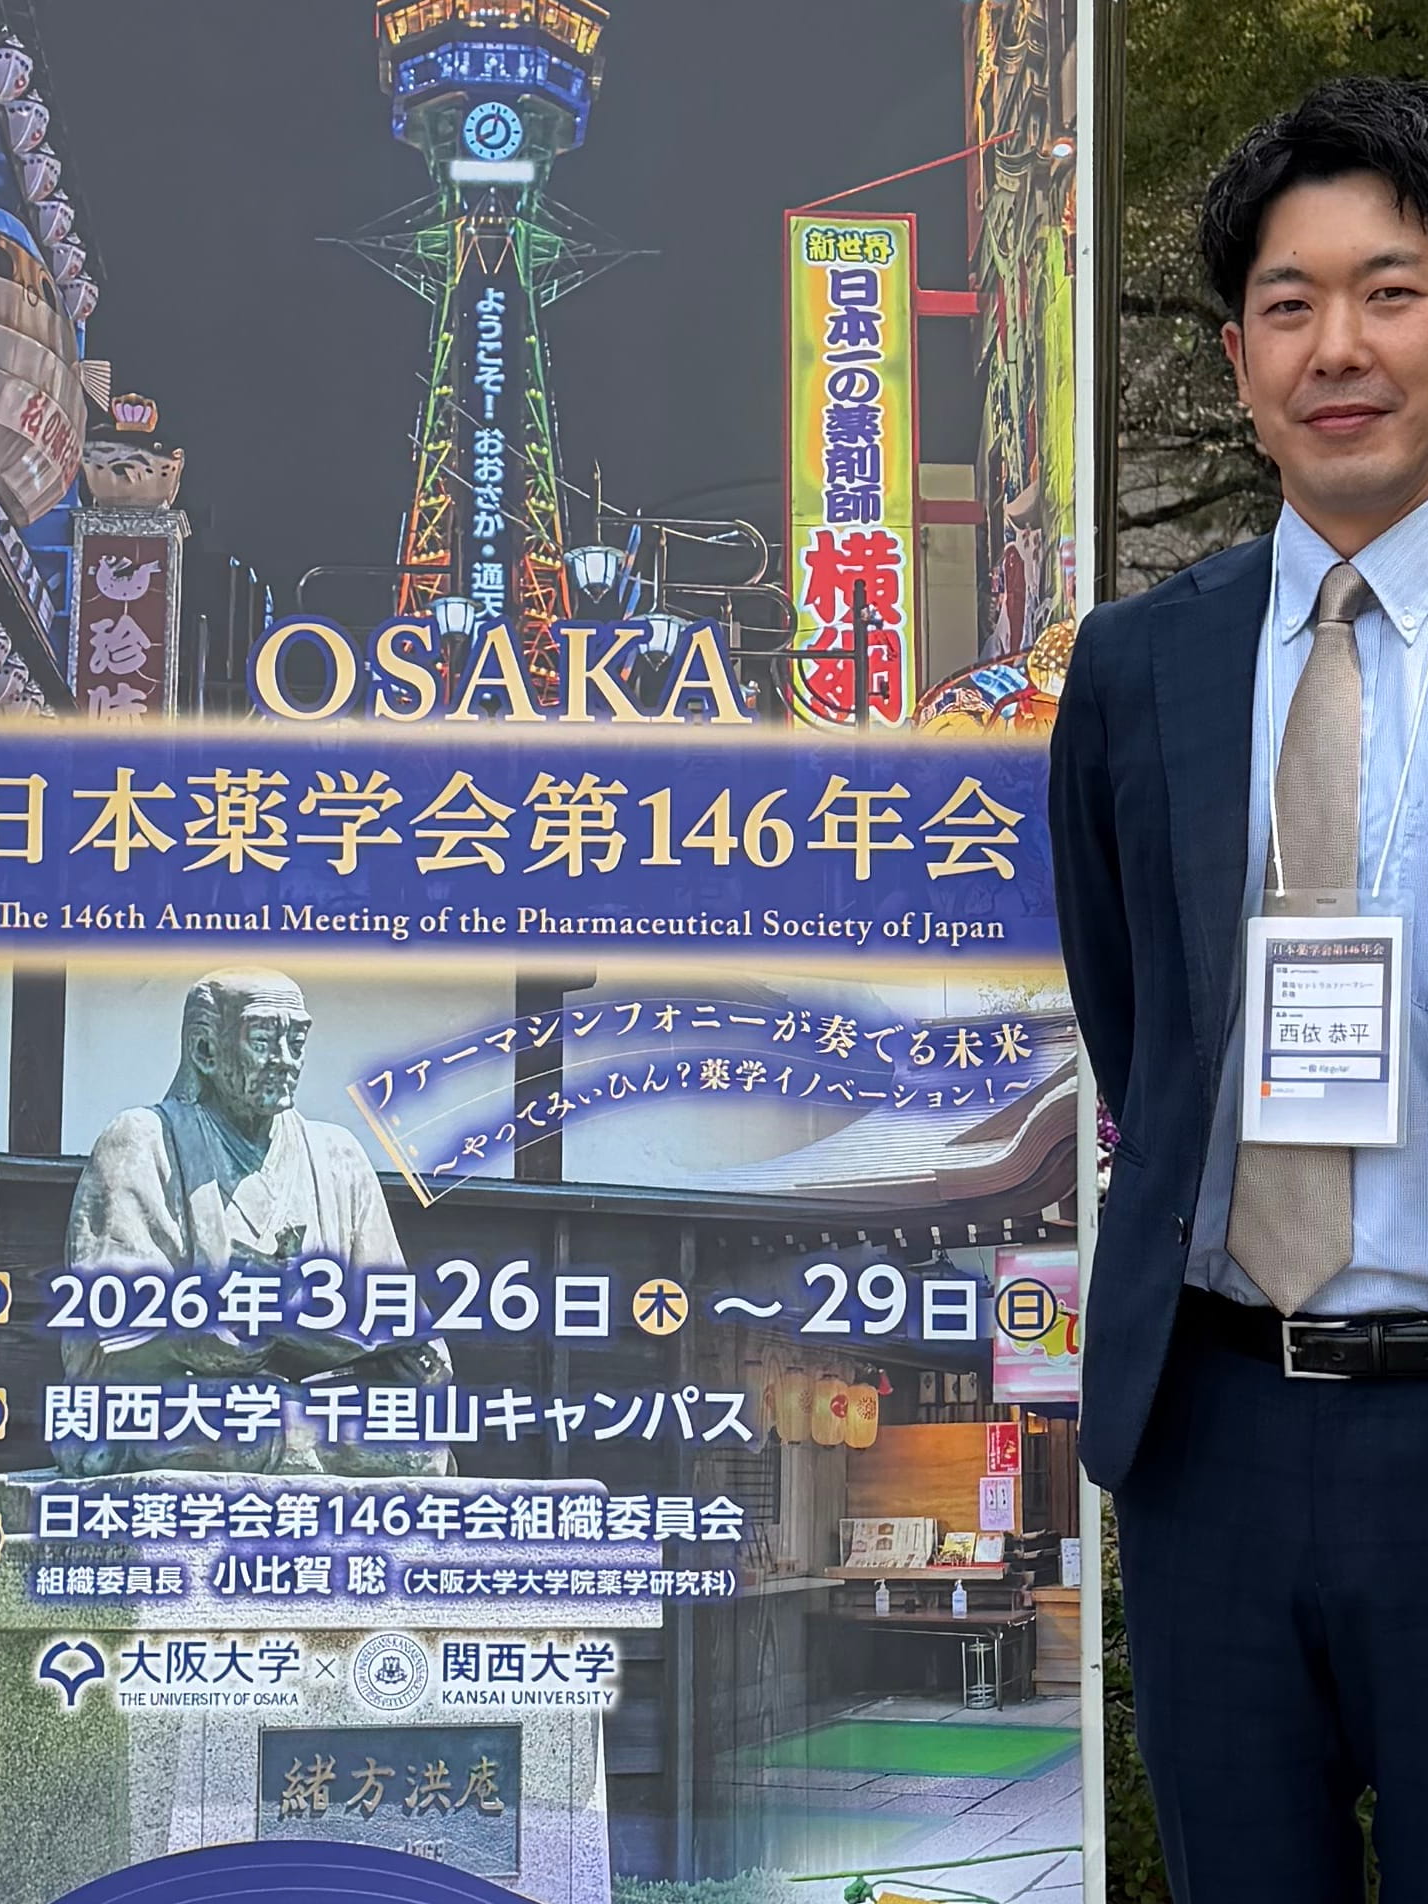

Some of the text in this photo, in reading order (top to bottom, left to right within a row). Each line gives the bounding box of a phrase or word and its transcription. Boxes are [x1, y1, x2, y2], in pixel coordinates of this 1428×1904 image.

[807, 229, 894, 264] 新世界
[825, 268, 882, 525] 日本一の薬剤師
[254, 620, 753, 725] OSAKA
[60, 903, 146, 931] 146th
[156, 903, 271, 932] Annual
[280, 904, 410, 941] Meeting
[419, 906, 454, 934] of
[459, 907, 507, 935] the
[516, 907, 752, 937] Pharmaceutical
[762, 909, 874, 946] Society
[883, 911, 916, 939] of
[916, 912, 1005, 948] Japan
[367, 1000, 1035, 1109] ファーマシンフォニーが奏でる未来
[1278, 1022, 1370, 1045] 西依 恭平
[45, 1384, 281, 1443] 関西大学
[305, 1384, 754, 1444] 千里山キャンパス
[38, 1492, 745, 1543] 日本薬学会第146年会組織委員会
[36, 1555, 737, 1598] 組織委員長 小比賀 聡 (大阪大学大学院薬学研究科)
[119, 1639, 301, 1685] 大阪大学
[441, 1641, 616, 1685] 関西大学
[119, 1692, 300, 1707] THE UNIVERSITY OF OSAKA
[441, 1690, 615, 1706] KANSAI UNIVERSITY
[280, 1752, 506, 1816] 緒方洪庵
